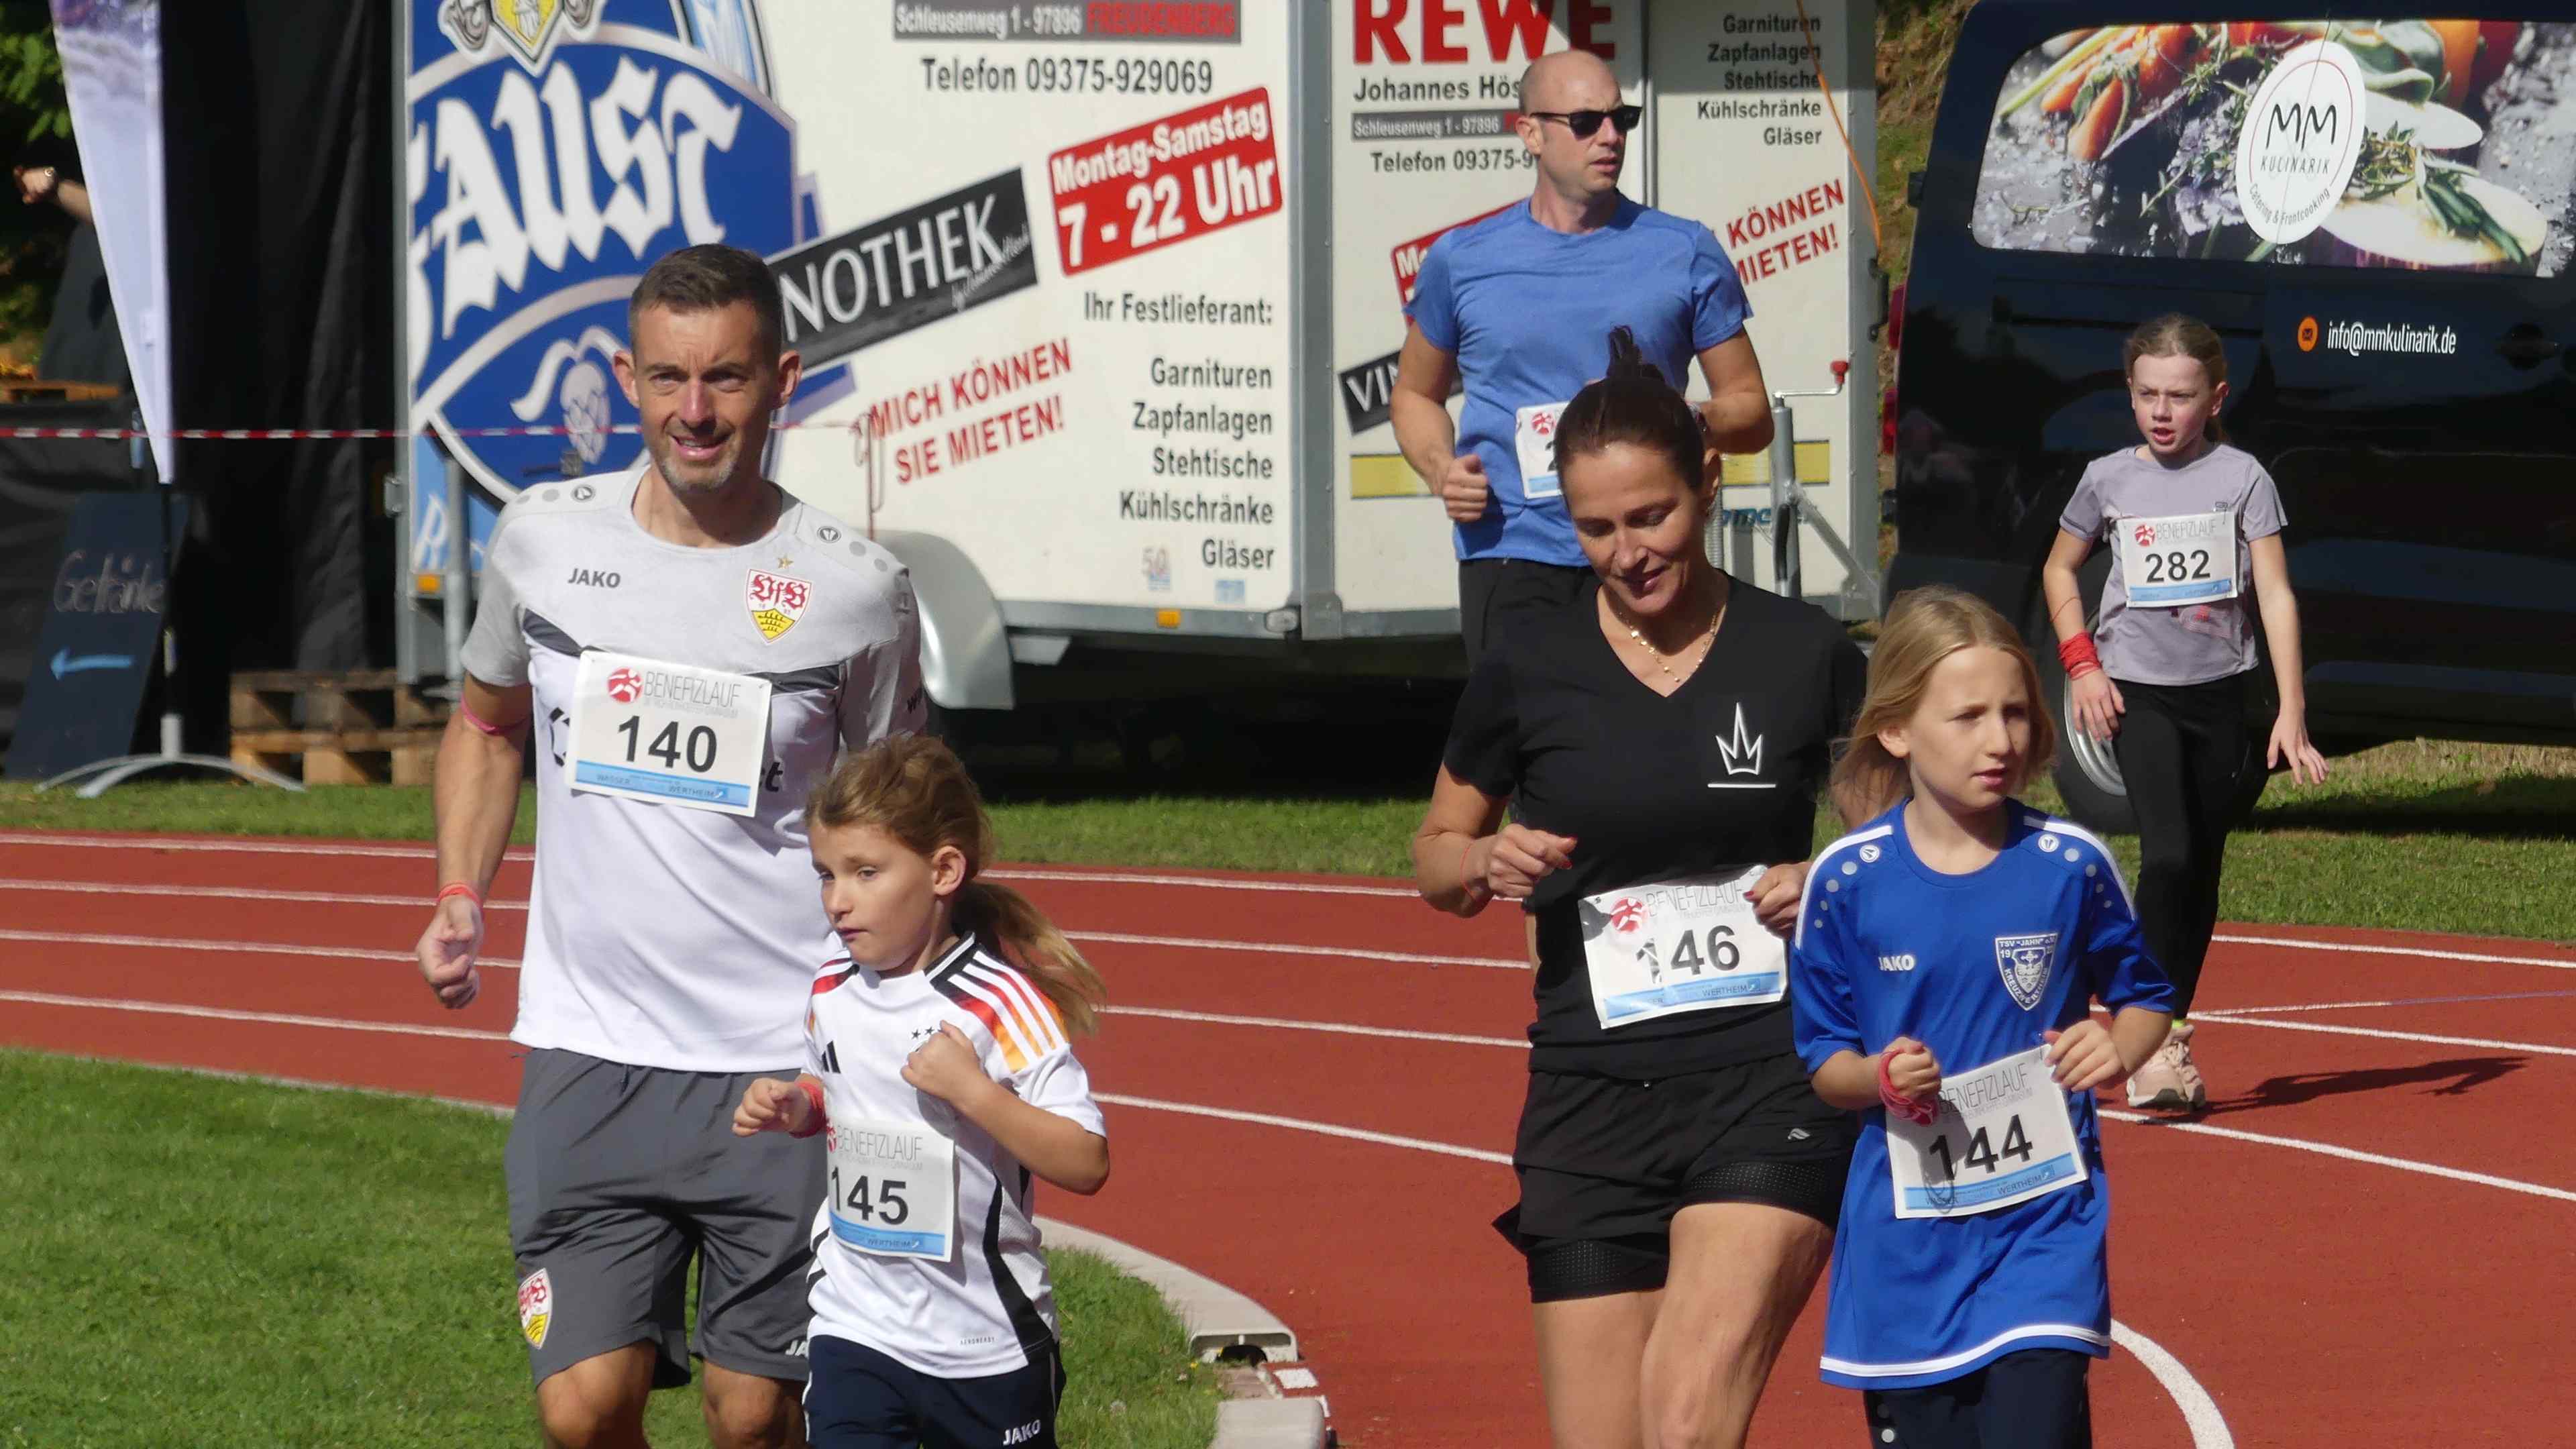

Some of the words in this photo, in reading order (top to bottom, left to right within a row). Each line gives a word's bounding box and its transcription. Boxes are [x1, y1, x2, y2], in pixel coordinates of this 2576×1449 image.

[896, 5, 1006, 39] Schleusenweg
[1010, 7, 1020, 33] 1
[1033, 7, 1081, 34] 97896
[1087, 1, 1236, 36] FREUDENBERG
[1353, 0, 1617, 64] REWE
[921, 57, 1016, 91] Telefon
[1027, 58, 1213, 93] 09375-929069
[1354, 76, 1469, 102] Johannes
[1354, 119, 1440, 138] Schleusenweg
[1444, 119, 1450, 134] 1
[1462, 115, 1499, 134] 97896
[1698, 99, 1821, 119] Kühlschränke
[2266, 103, 2337, 150] MM
[1051, 103, 1269, 195] Montag-Samstag
[1764, 127, 1822, 146] Gläser
[1370, 152, 1446, 172] Telefon
[1454, 149, 1539, 170] 09375-9
[2260, 155, 2330, 174] KULINARIK
[1058, 202, 1087, 267] 7
[1125, 174, 1185, 248] 22
[1192, 154, 1275, 225] Uhr
[1727, 178, 1845, 249] KÖNNEN
[2249, 183, 2271, 224] Catering
[2272, 210, 2280, 224] &
[2280, 188, 2330, 225] Frontcooking
[1084, 292, 1114, 321] Ihr
[1122, 292, 1273, 325] Festlieferant:
[2327, 320, 2457, 356] info@mmkulinarik.de
[869, 382, 943, 439] MICH
[951, 337, 1071, 411] KÖNNEN
[1151, 357, 1273, 389] Garnituren
[1132, 401, 1273, 441] Zapfanlagen
[895, 438, 940, 484] SIE
[947, 394, 1063, 466] MIETEN!
[1153, 446, 1273, 479] Stehtische
[1120, 491, 1273, 525] Kühlschränke
[2155, 519, 2216, 541] BENEFIZLAUF
[1202, 539, 1274, 569] Gläser
[2145, 549, 2210, 583] 282
[568, 568, 621, 588] JAKO
[643, 671, 741, 708] BENEFIZLAUF
[619, 715, 717, 773] 140
[1635, 925, 1739, 984] 146
[1703, 984, 1748, 997] WERTHEIM
[1929, 1114, 2033, 1181] 144
[832, 1166, 908, 1225] 145
[1997, 1175, 2042, 1195] WERTHEIM
[1003, 1419, 1042, 1446] JAKO
